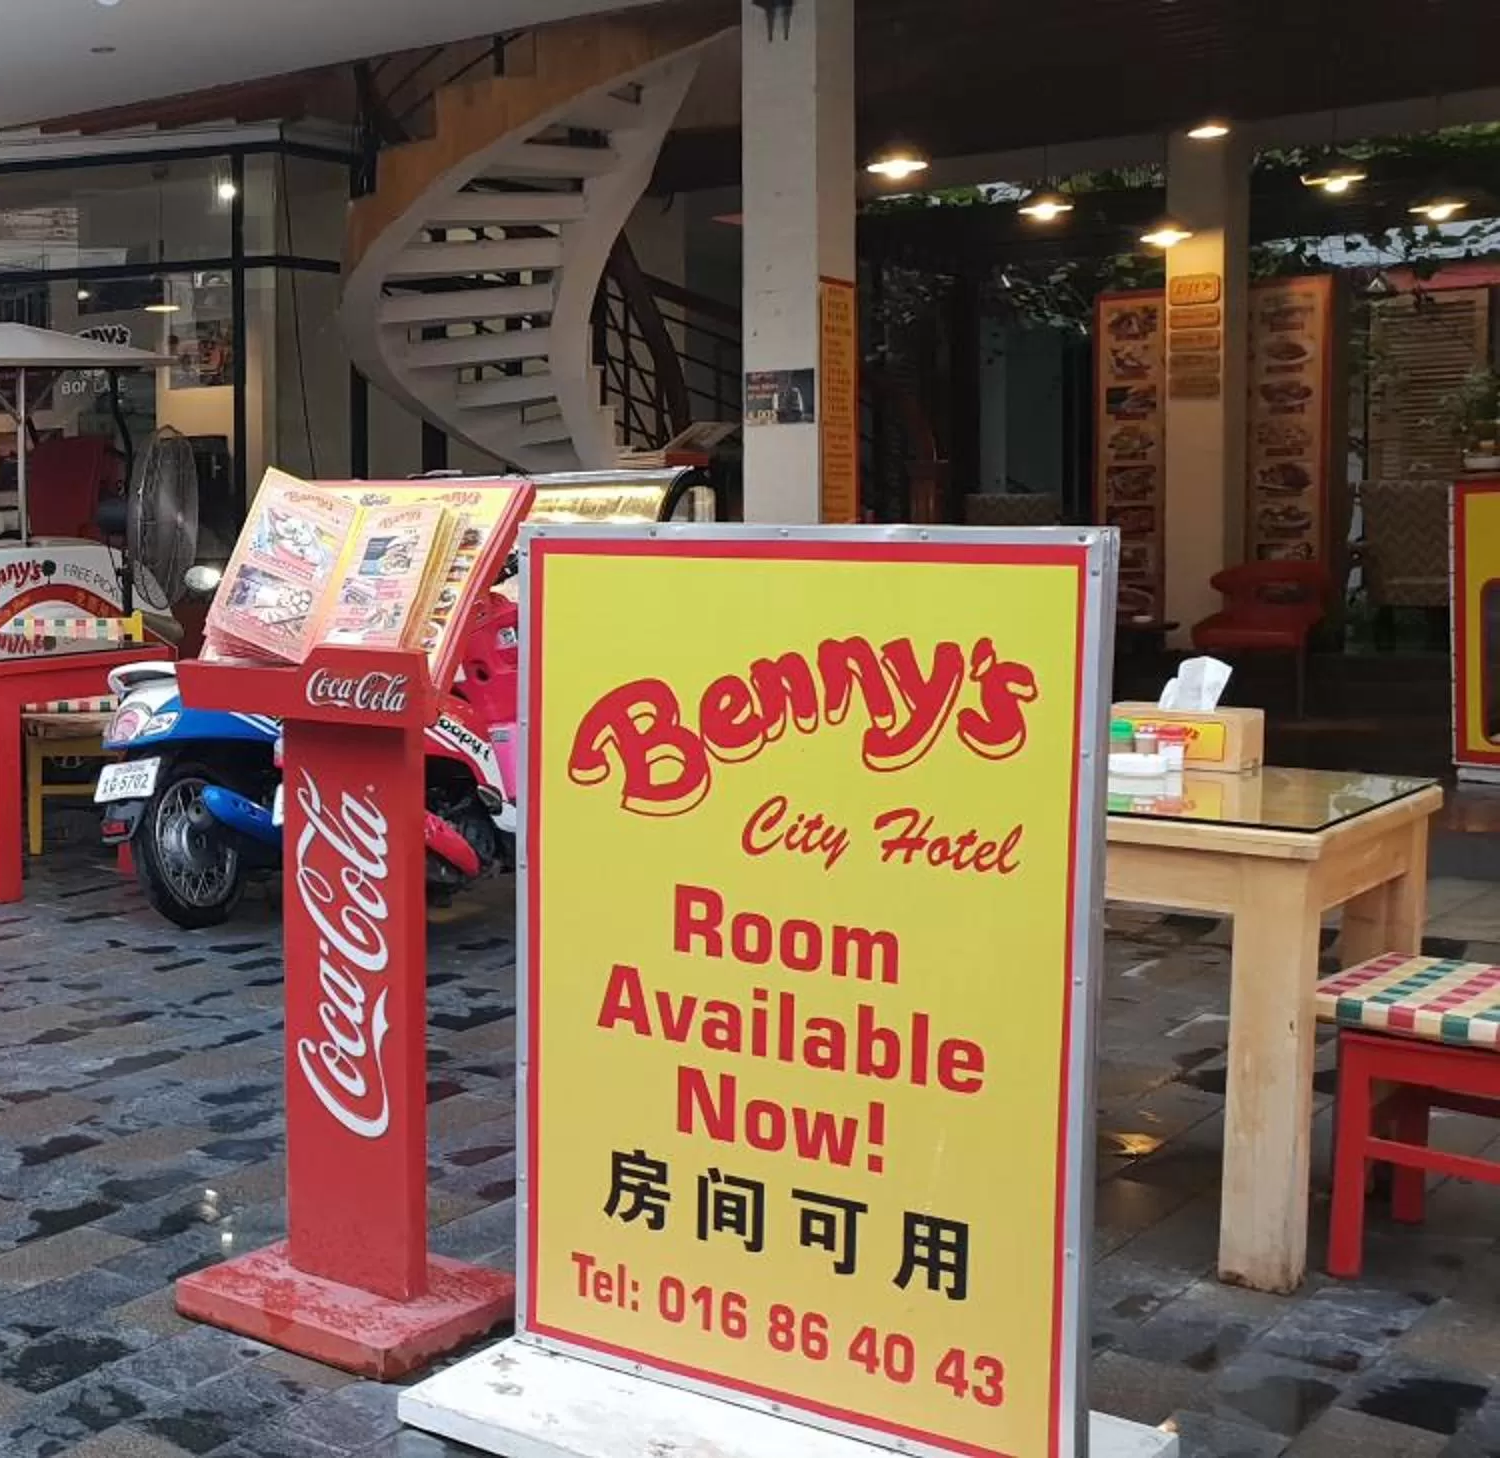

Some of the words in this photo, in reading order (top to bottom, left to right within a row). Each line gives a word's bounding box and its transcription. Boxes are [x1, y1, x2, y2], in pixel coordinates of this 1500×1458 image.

[305, 667, 408, 712] Coca-Cola
[567, 635, 1039, 817] Benny's
[741, 796, 849, 870] City
[873, 808, 1024, 874] Hotel
[298, 767, 389, 1138] Coca-Cola
[673, 884, 900, 984] Room
[597, 964, 986, 1094] Available
[676, 1066, 885, 1173] Now!
[603, 1149, 970, 1301] 房间可用
[571, 1252, 640, 1312] Tel:
[659, 1276, 748, 1340] 016
[768, 1304, 829, 1361] 86
[848, 1326, 916, 1385] 40
[935, 1348, 1006, 1408] 43
